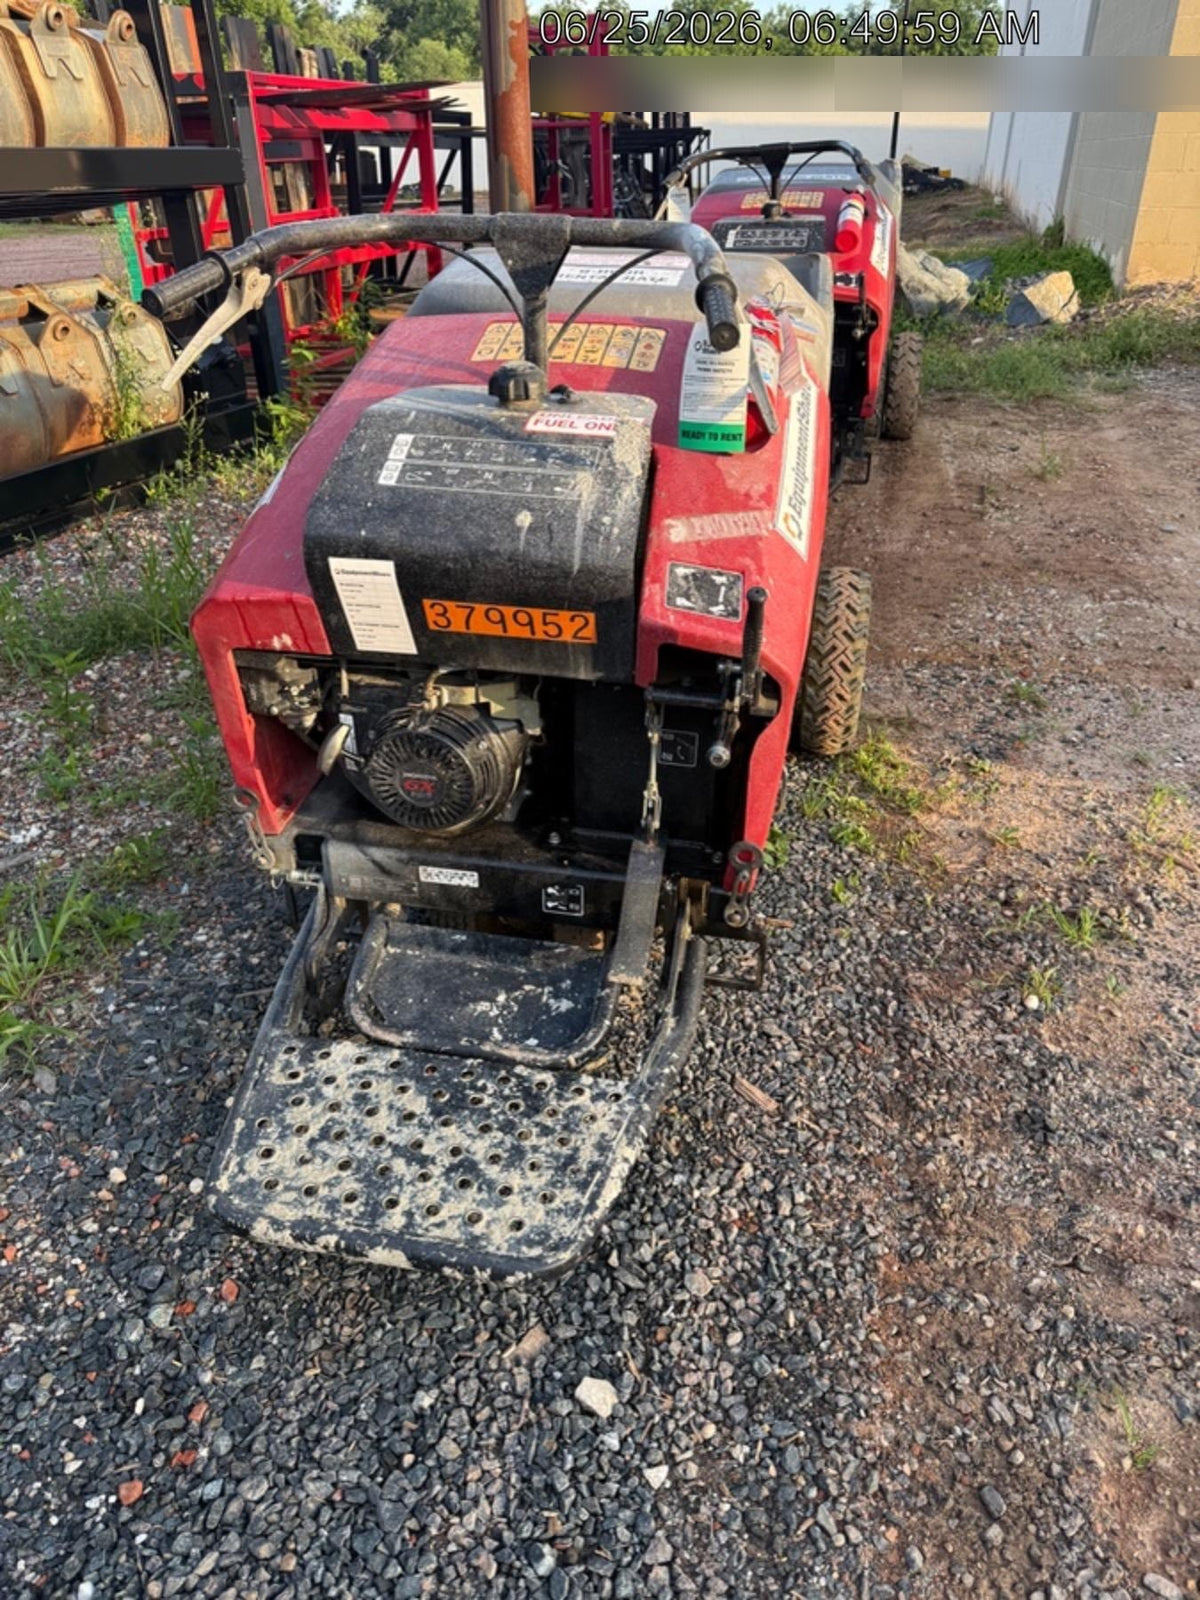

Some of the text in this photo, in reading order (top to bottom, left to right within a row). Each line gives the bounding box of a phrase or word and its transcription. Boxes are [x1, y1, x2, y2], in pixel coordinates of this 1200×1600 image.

[533, 418, 578, 429] FUEL
[682, 430, 743, 442] READY TO RENT
[429, 602, 594, 641] 379952
